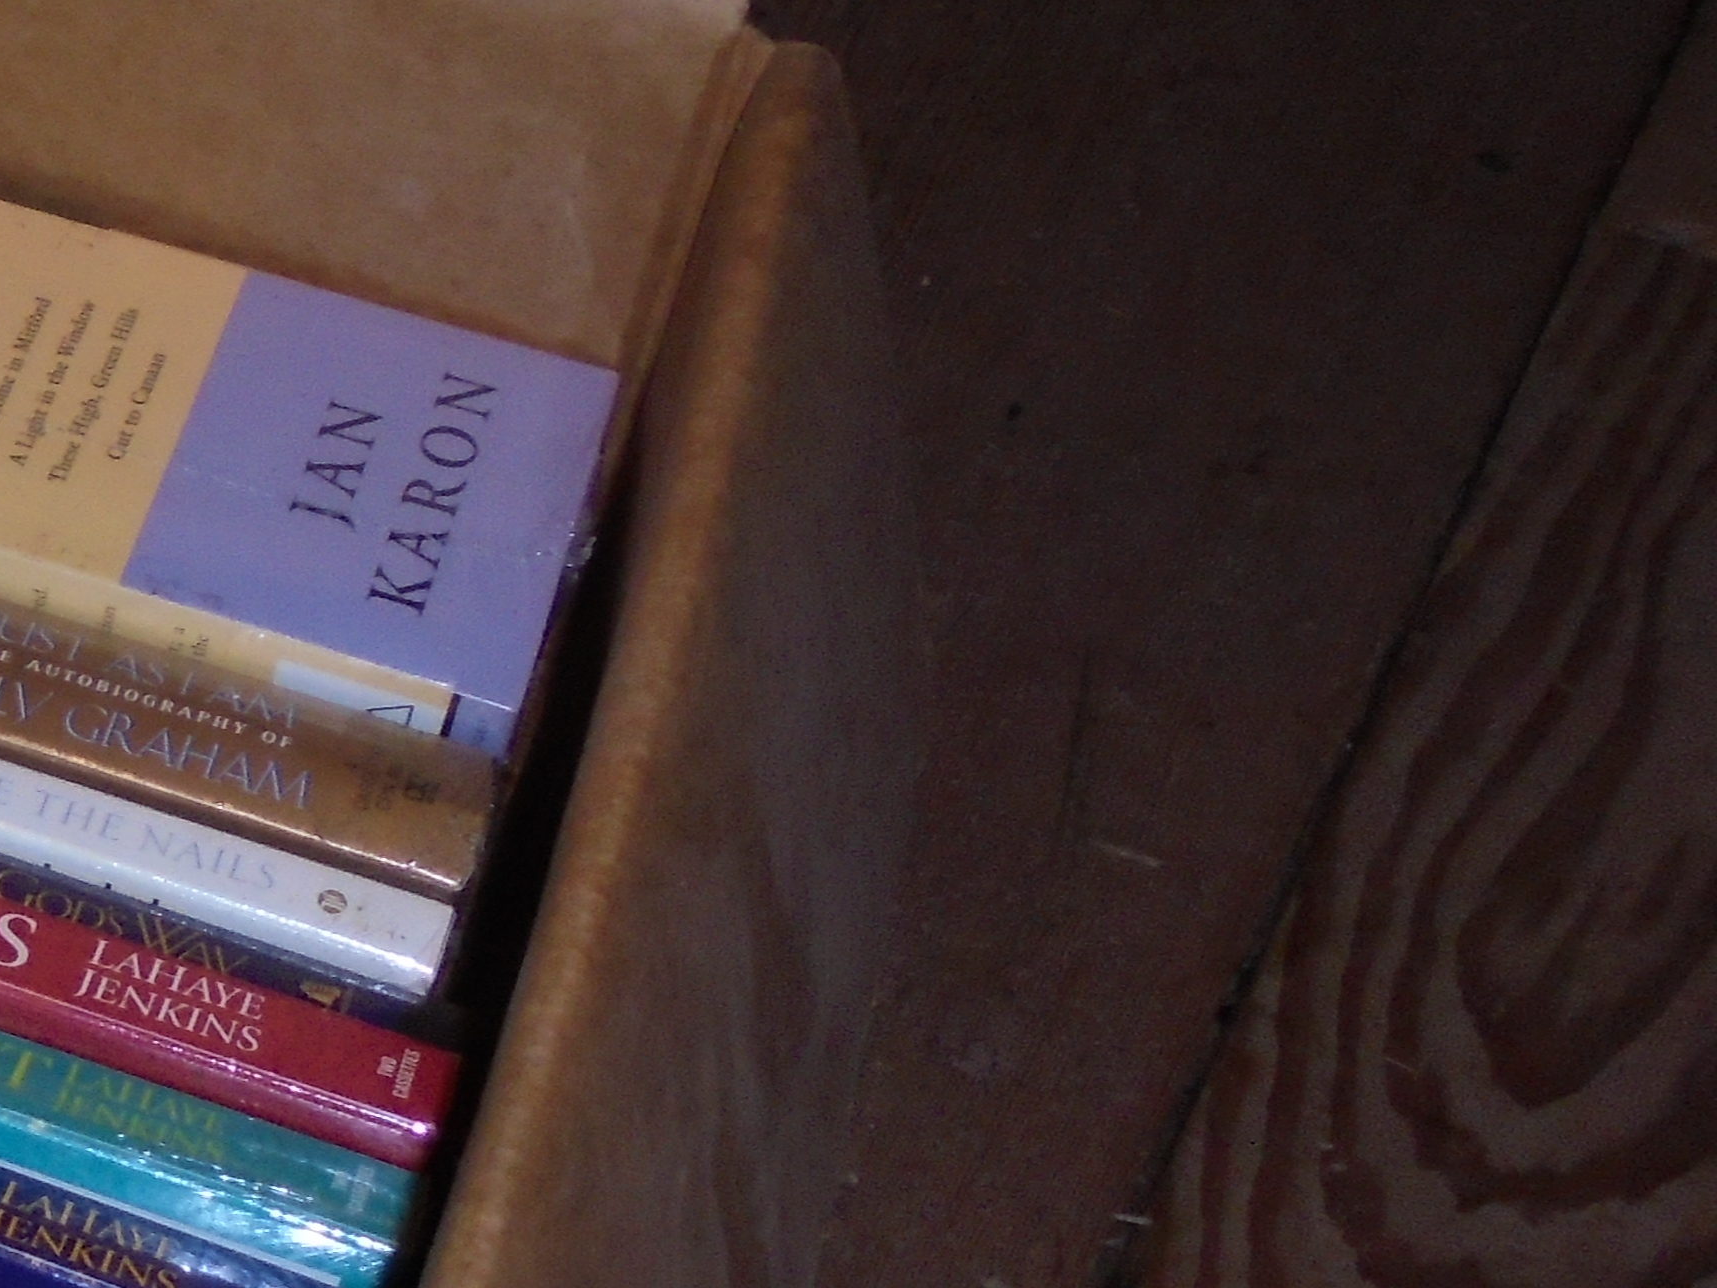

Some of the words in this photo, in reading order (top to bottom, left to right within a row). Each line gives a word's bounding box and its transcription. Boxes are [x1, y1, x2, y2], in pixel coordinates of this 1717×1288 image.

[56, 299, 96, 357] Window
[47, 362, 70, 386] the
[47, 440, 82, 482] These
[90, 345, 123, 389] Green
[110, 307, 140, 341] Hills
[130, 352, 167, 405] Canaan
[15, 408, 51, 450] Light
[124, 409, 142, 427] to
[9, 453, 29, 467] A
[288, 399, 384, 532] JAN
[366, 371, 499, 617] KARON
[25, 657, 249, 736] AUTOBIOGRAPHY
[260, 728, 295, 749] OF
[107, 652, 165, 688] AS
[204, 684, 302, 729] AM
[64, 702, 314, 810] GRAHAM
[36, 786, 121, 844] THE
[134, 823, 277, 891] NAILS
[73, 966, 263, 1053] JENKINS
[86, 938, 266, 1020] LAHAYE
